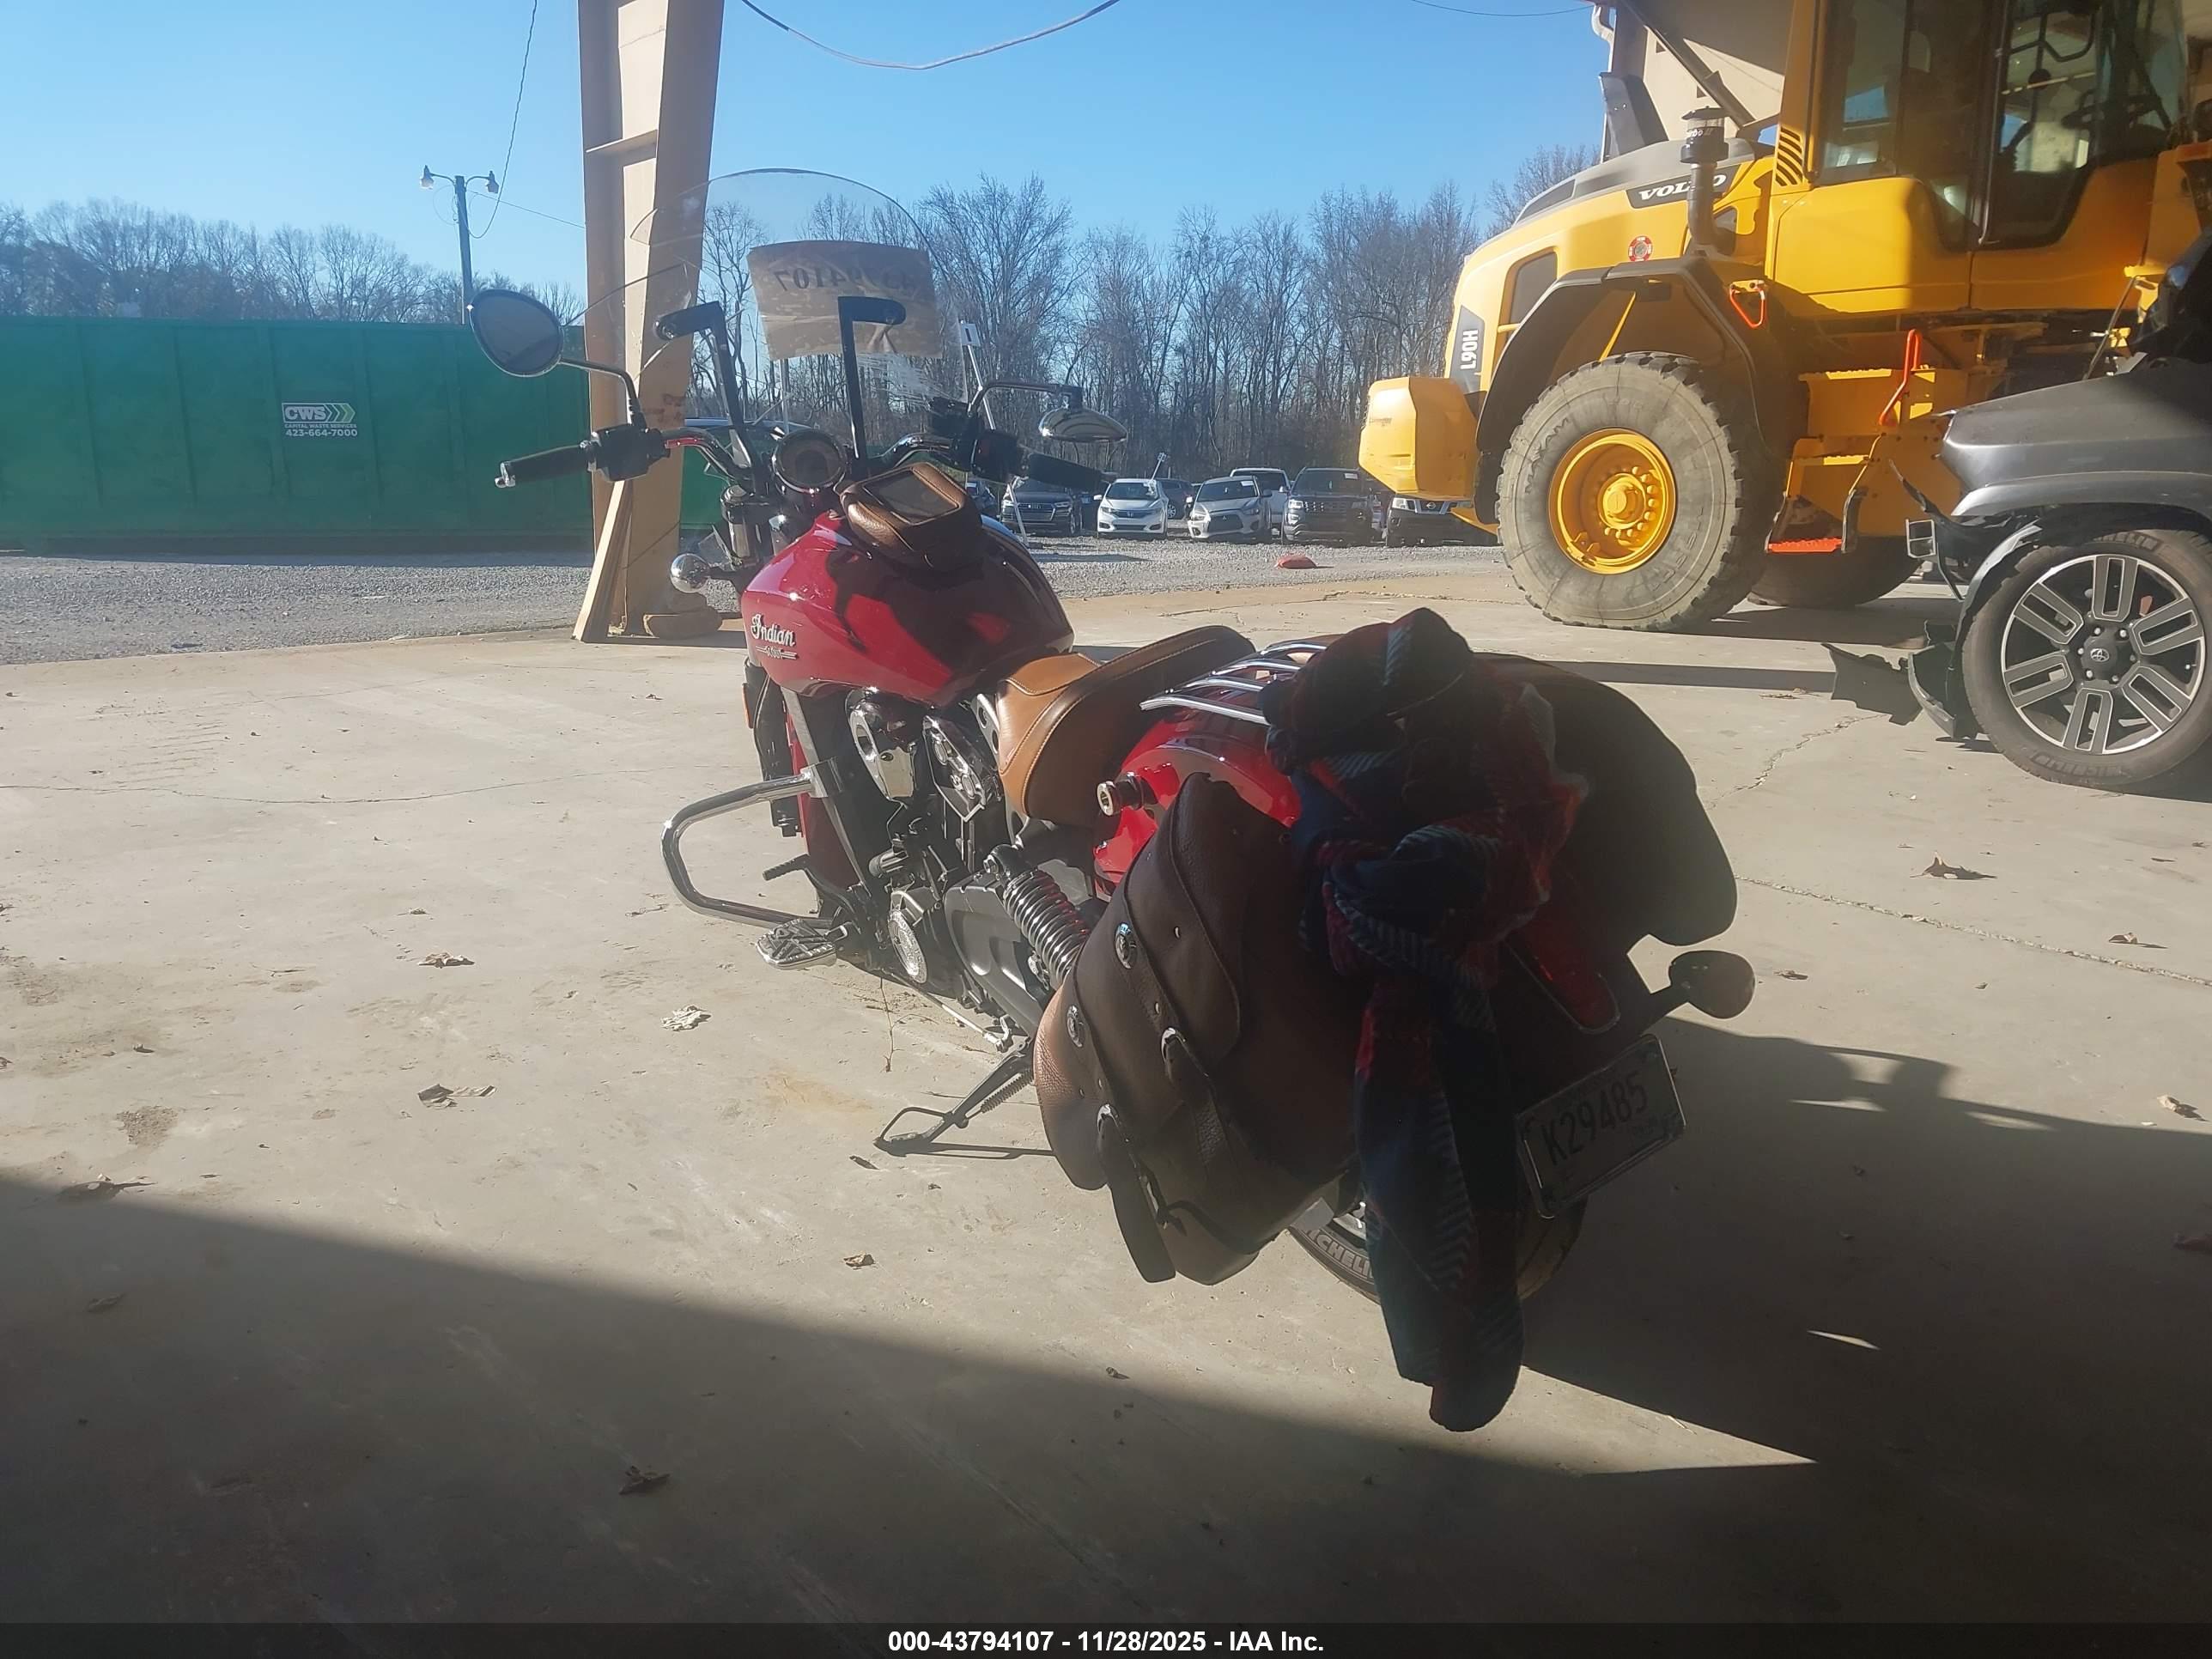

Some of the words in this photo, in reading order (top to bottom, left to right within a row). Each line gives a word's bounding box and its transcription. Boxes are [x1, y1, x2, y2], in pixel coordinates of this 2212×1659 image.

[1638, 174, 1727, 200] VOLO
[1460, 329, 1479, 370] L90H
[284, 405, 327, 420] CWS
[750, 613, 796, 647] Indian
[1542, 1071, 1648, 1166] K29485
